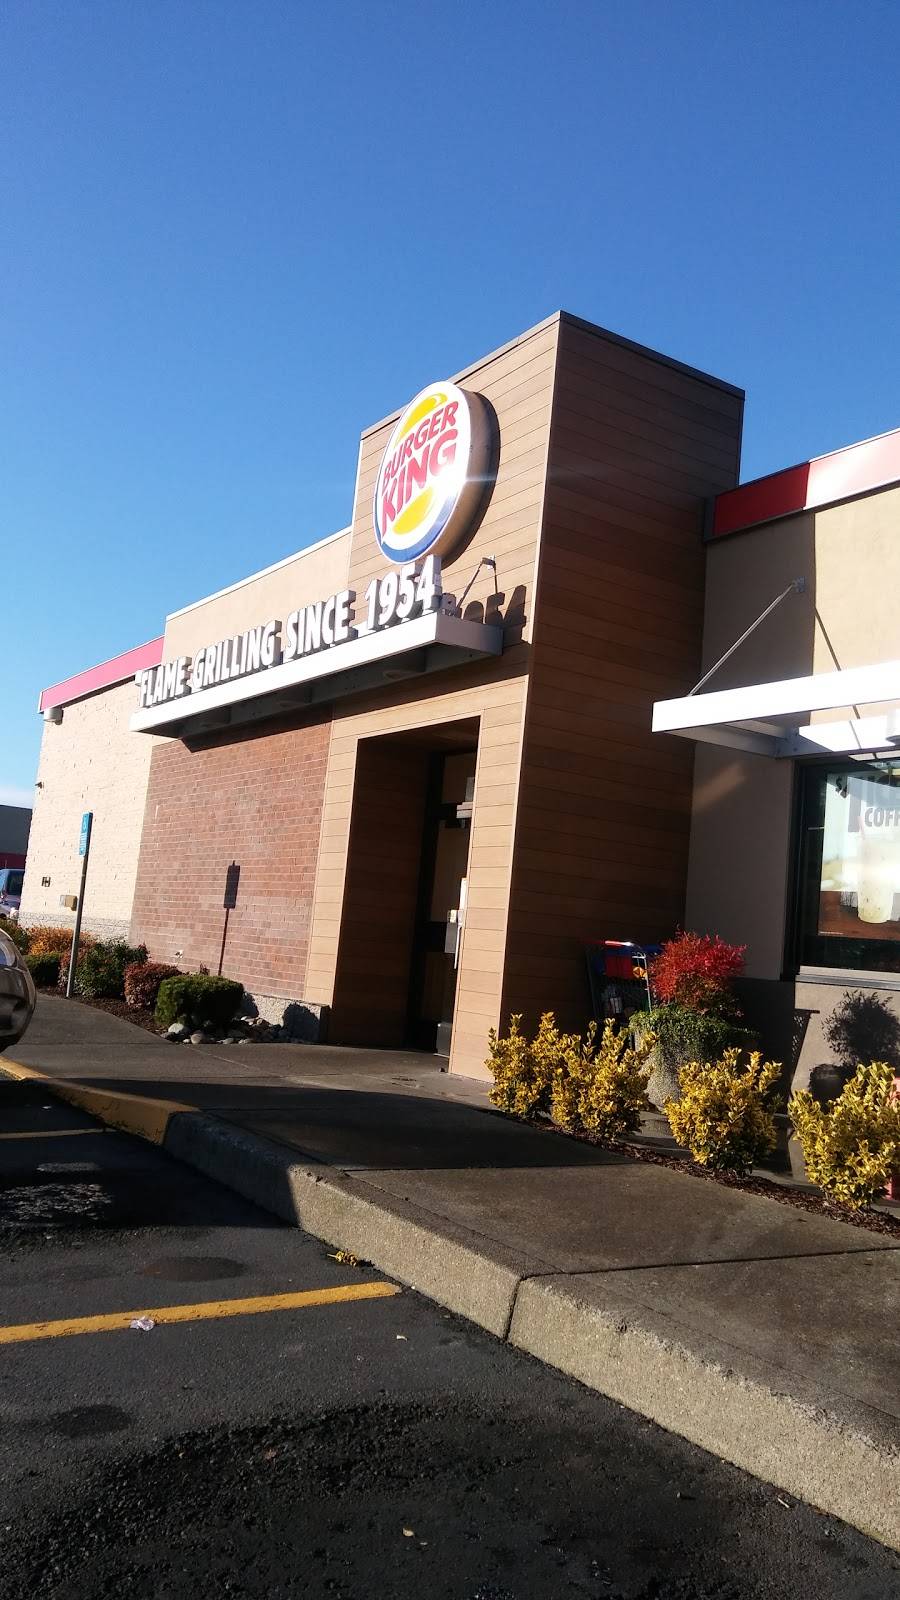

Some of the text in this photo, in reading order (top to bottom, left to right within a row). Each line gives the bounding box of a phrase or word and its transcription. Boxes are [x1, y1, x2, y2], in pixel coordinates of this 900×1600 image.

[382, 401, 458, 496] BURGER
[382, 428, 458, 541] KING
[138, 554, 437, 708] FLAME GRILLING SINCE 1954
